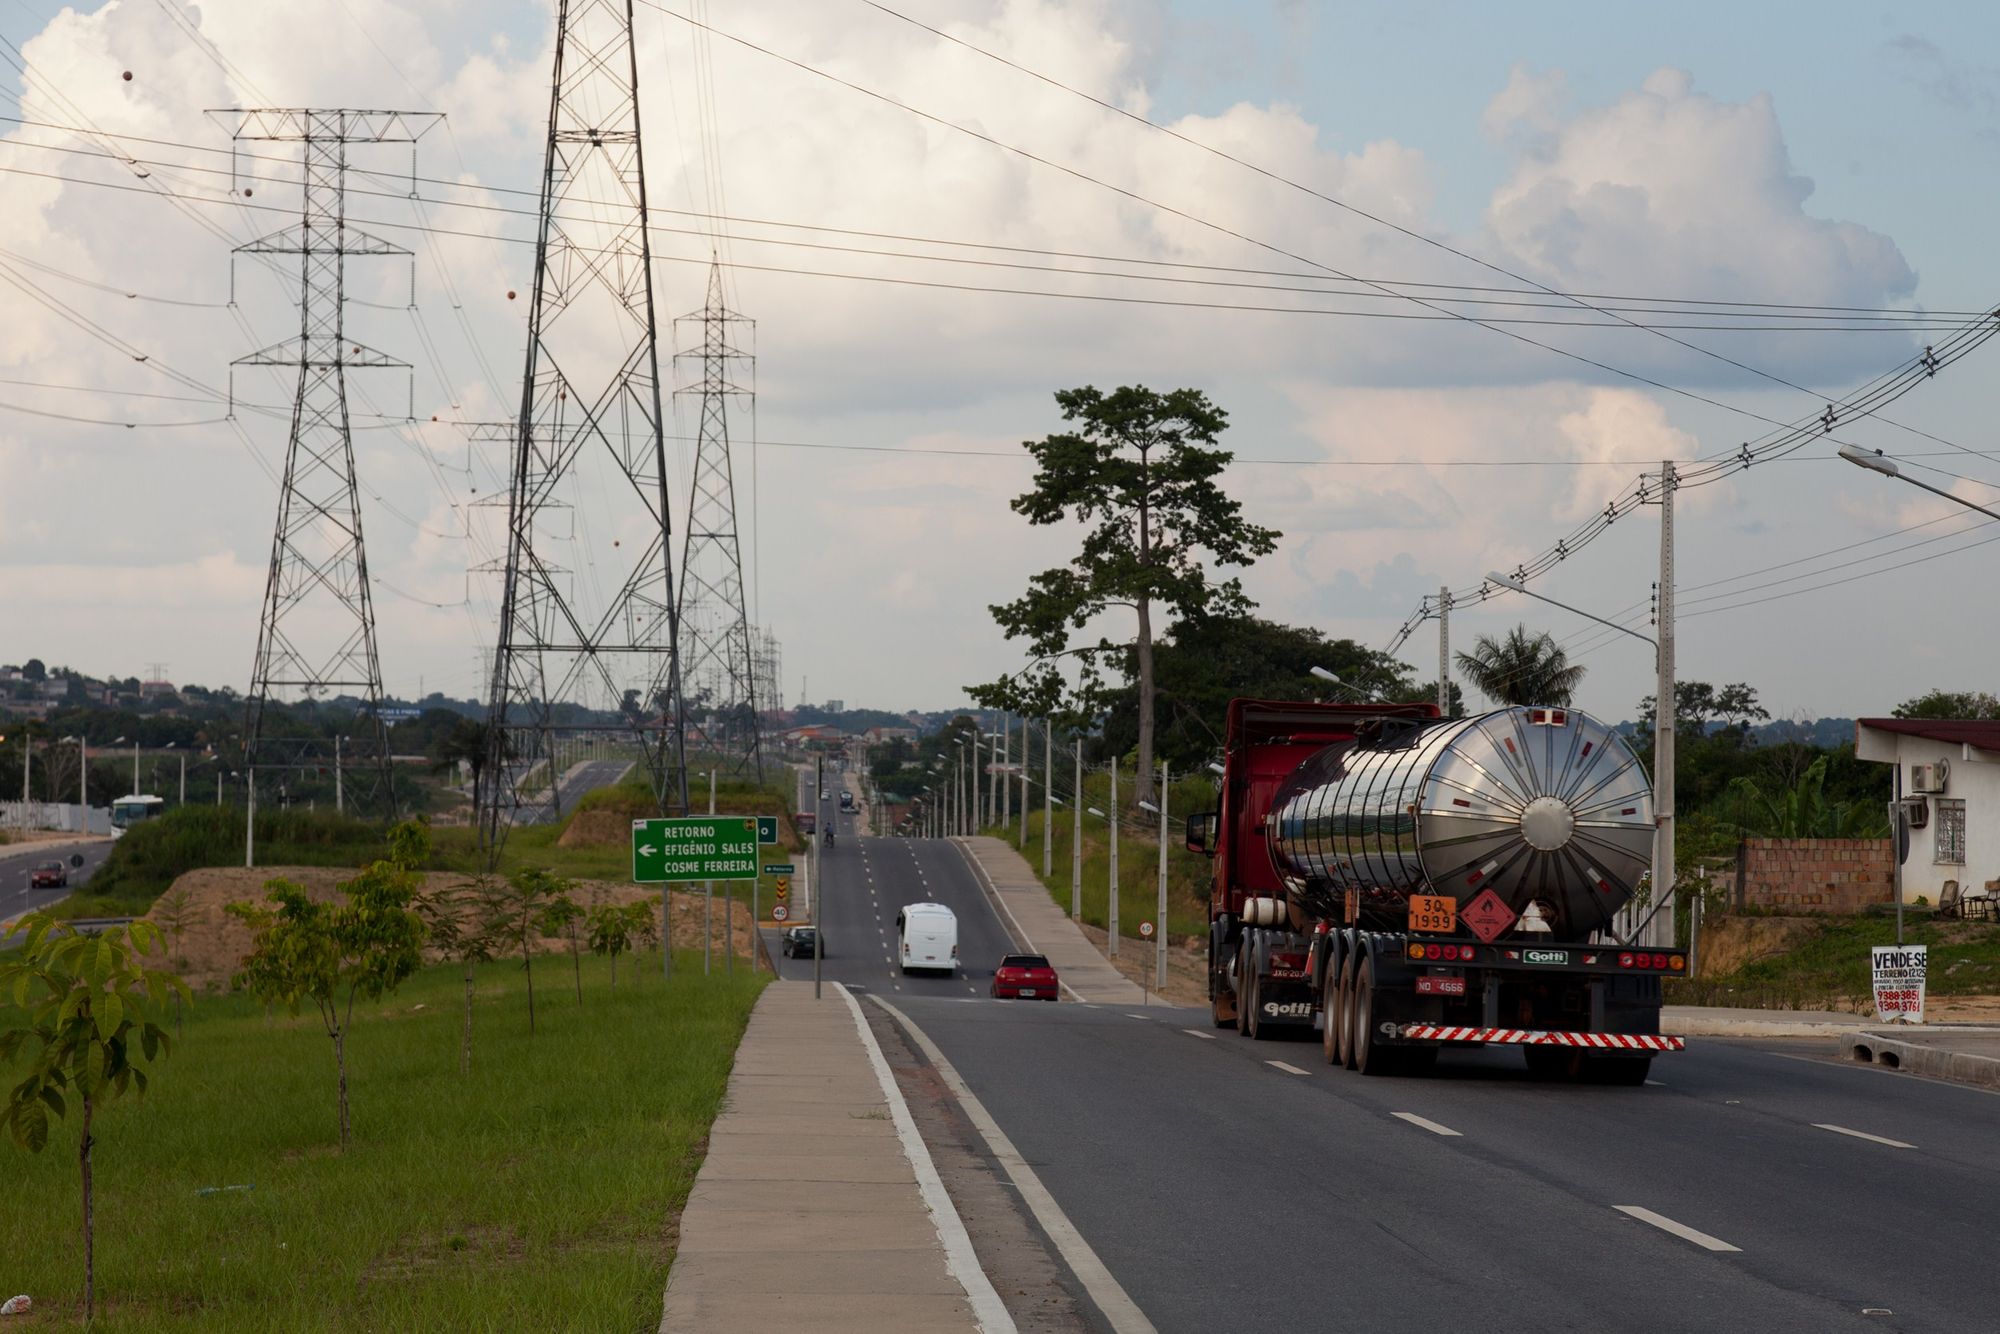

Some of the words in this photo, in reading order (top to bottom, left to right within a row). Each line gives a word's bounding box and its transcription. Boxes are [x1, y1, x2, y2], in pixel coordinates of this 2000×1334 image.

[665, 826, 715, 838] RETORNO
[665, 840, 716, 856] EFIGÊNIO
[721, 842, 754, 854] SALES
[665, 861, 699, 873] COSME
[704, 860, 755, 872] FERREIRA
[1424, 899, 1441, 912] 30
[1415, 914, 1450, 929] 1999
[1484, 927, 1490, 935] 3
[1874, 969, 1908, 978] TERRENO
